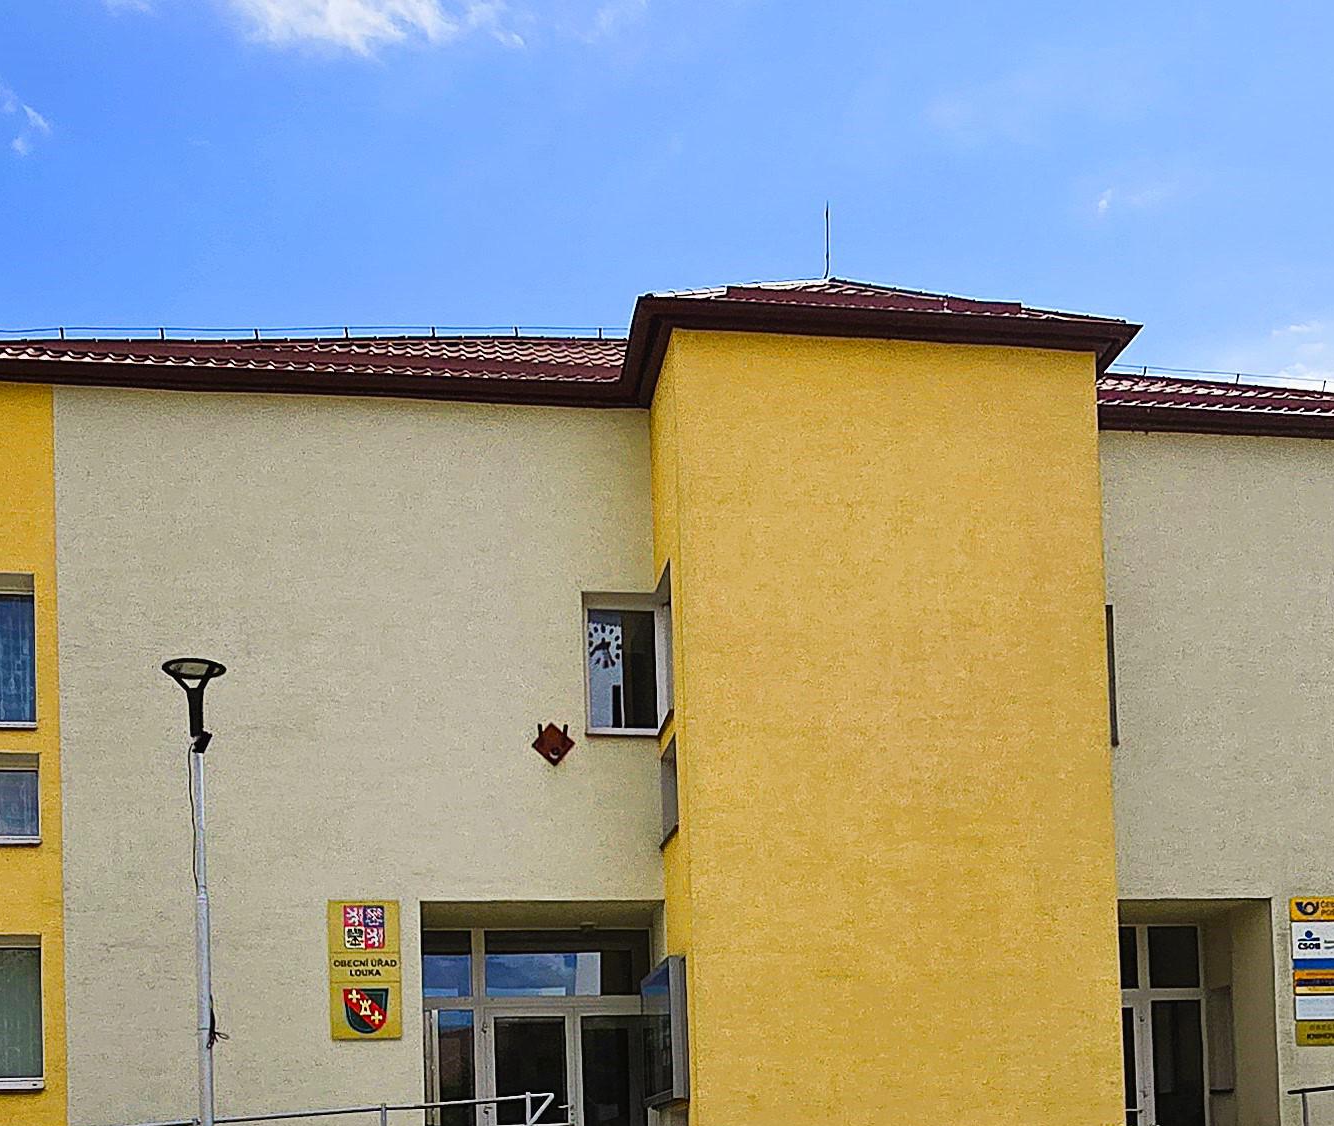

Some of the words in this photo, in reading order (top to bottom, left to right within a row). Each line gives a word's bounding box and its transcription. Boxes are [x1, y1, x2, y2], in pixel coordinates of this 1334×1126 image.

[333, 958, 369, 968] OBECNÍ
[370, 957, 397, 968] ÚŘAD
[349, 969, 382, 977] LOUKA
